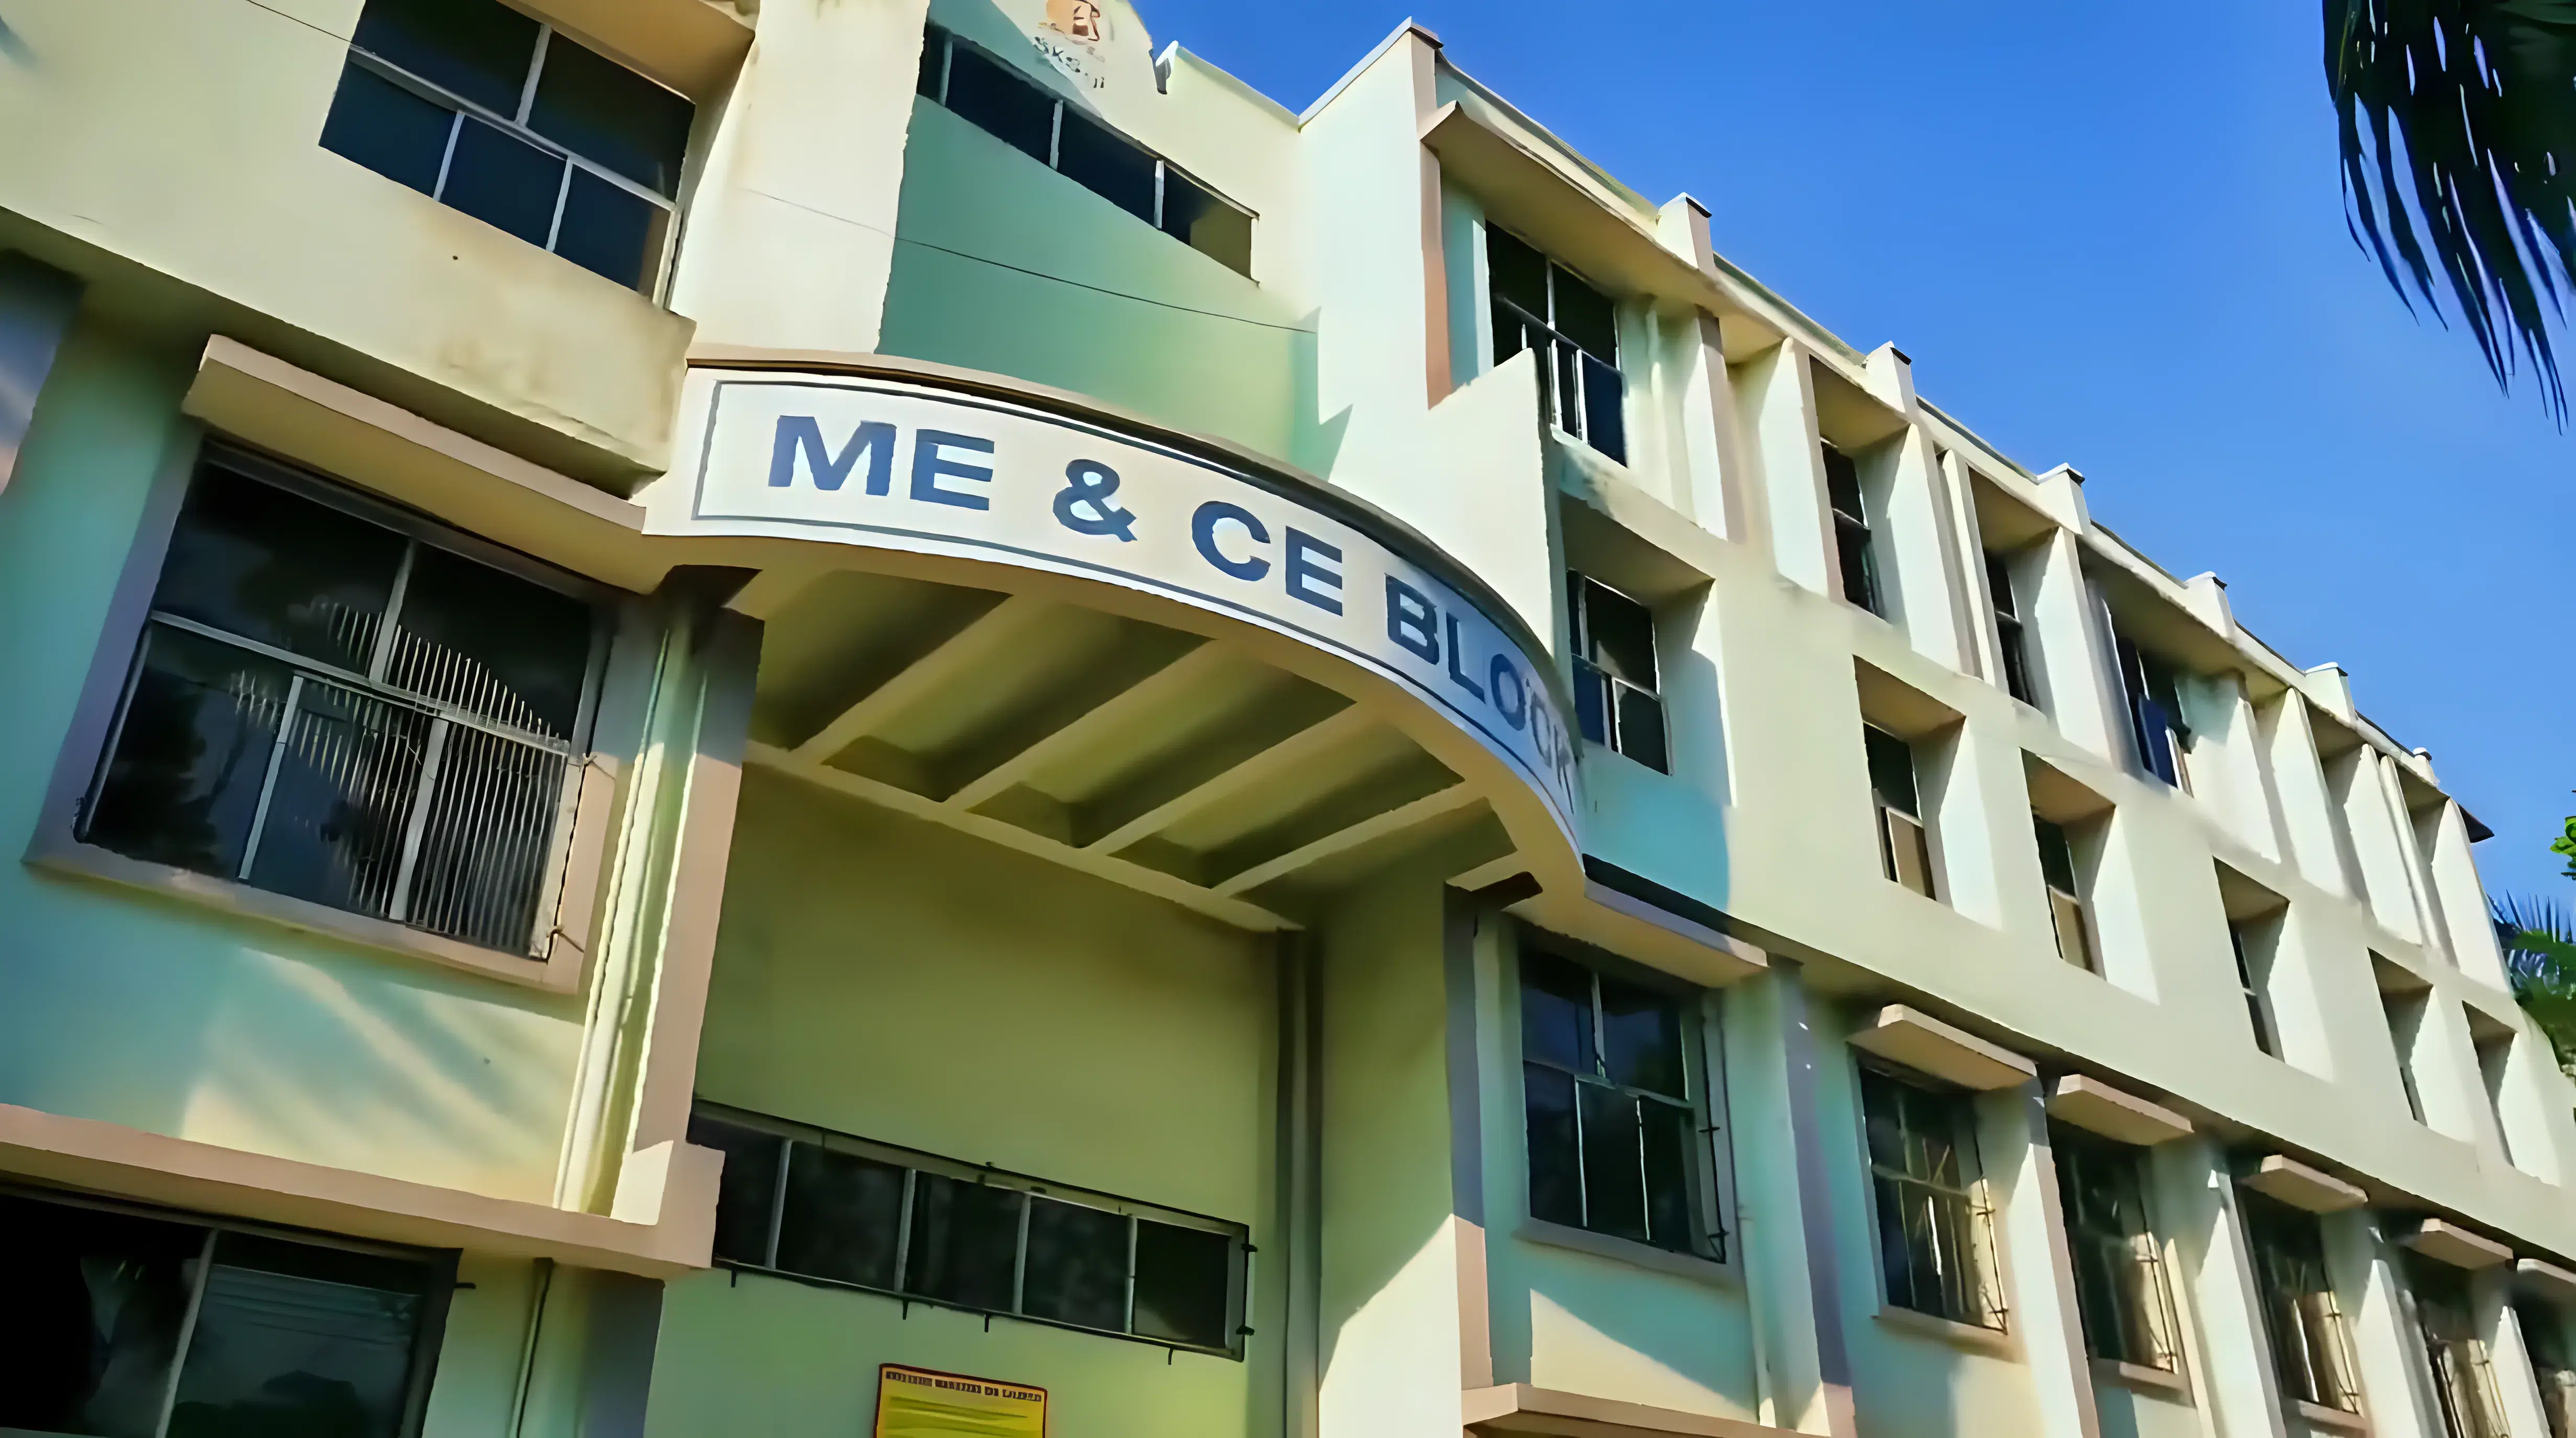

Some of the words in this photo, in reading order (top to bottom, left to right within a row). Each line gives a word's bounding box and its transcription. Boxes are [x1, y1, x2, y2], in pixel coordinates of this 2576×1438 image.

[768, 415, 995, 511] ME
[1053, 458, 1138, 542] &
[1192, 500, 1343, 617] CE
[1385, 572, 1574, 815] BLOCK
